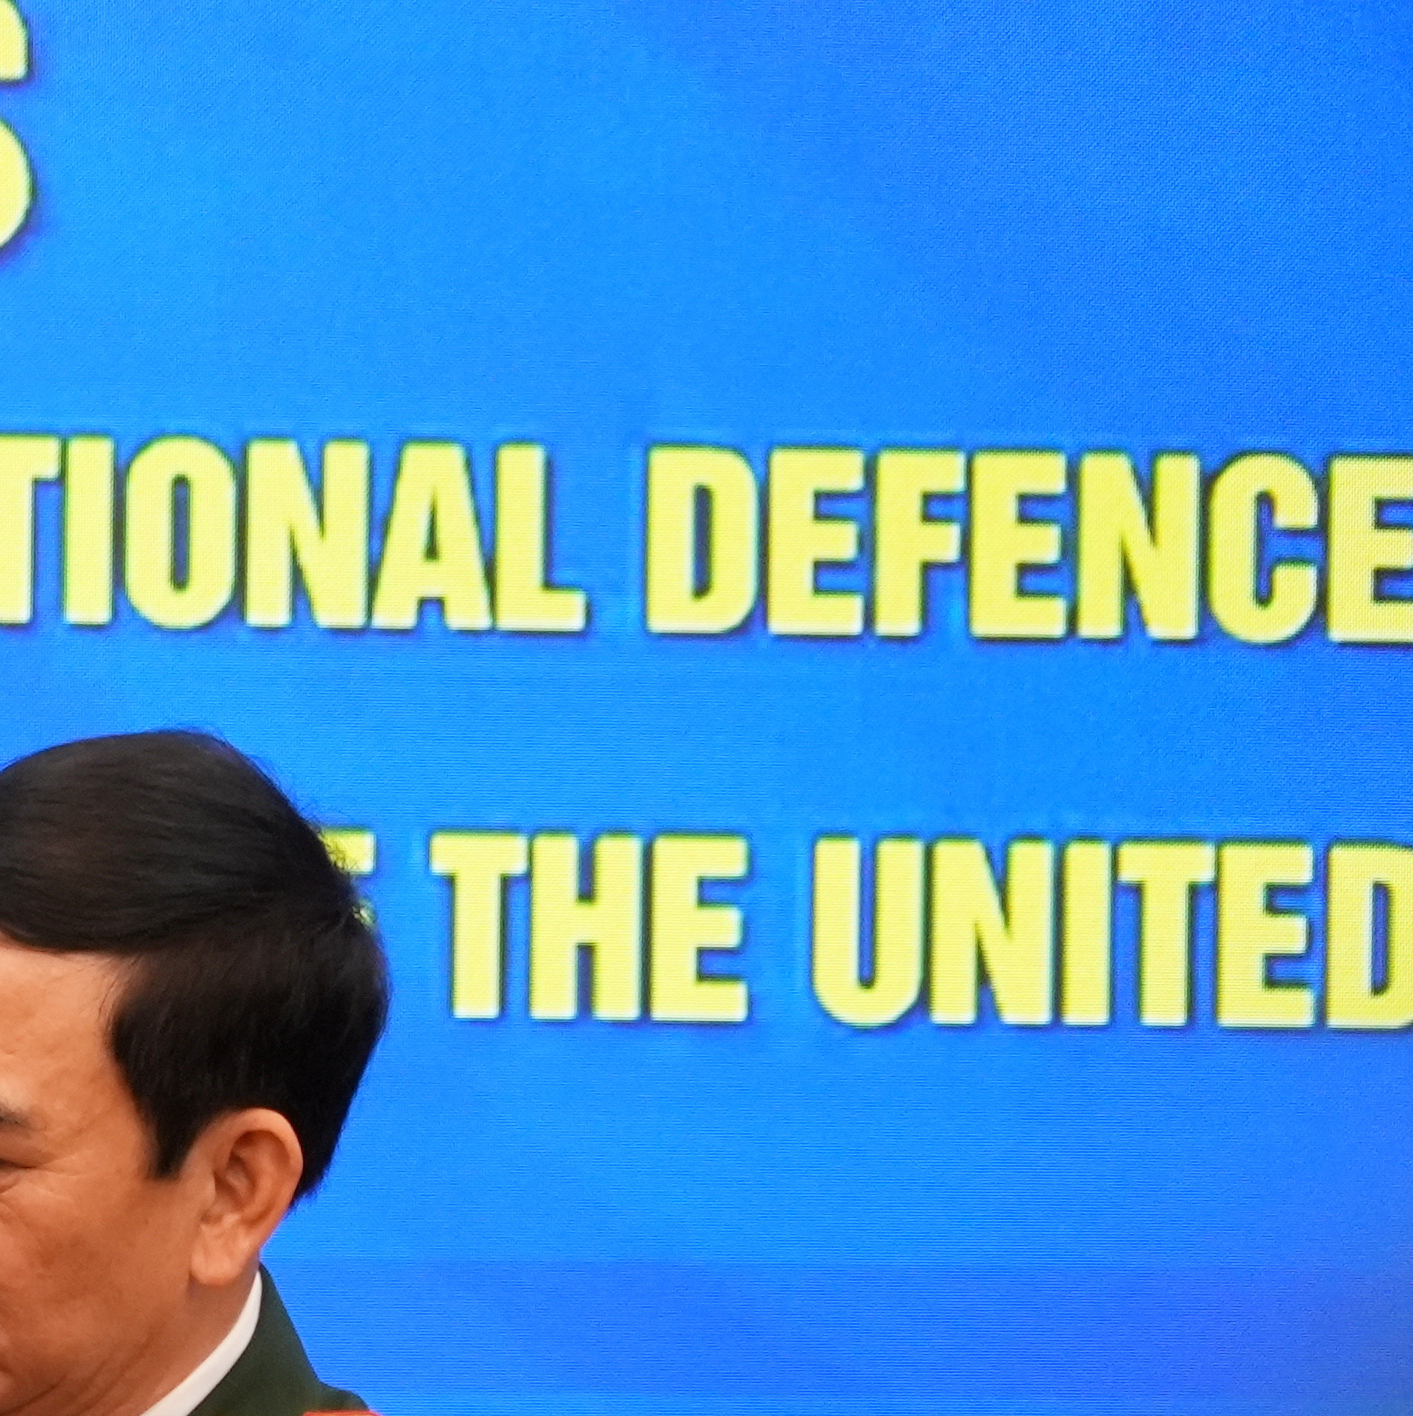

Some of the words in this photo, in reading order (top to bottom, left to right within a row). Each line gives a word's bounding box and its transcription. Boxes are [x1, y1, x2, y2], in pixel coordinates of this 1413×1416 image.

[645, 445, 1413, 646] DEFENCE
[428, 831, 748, 1024] THE
[811, 836, 1413, 1030] UNITED
